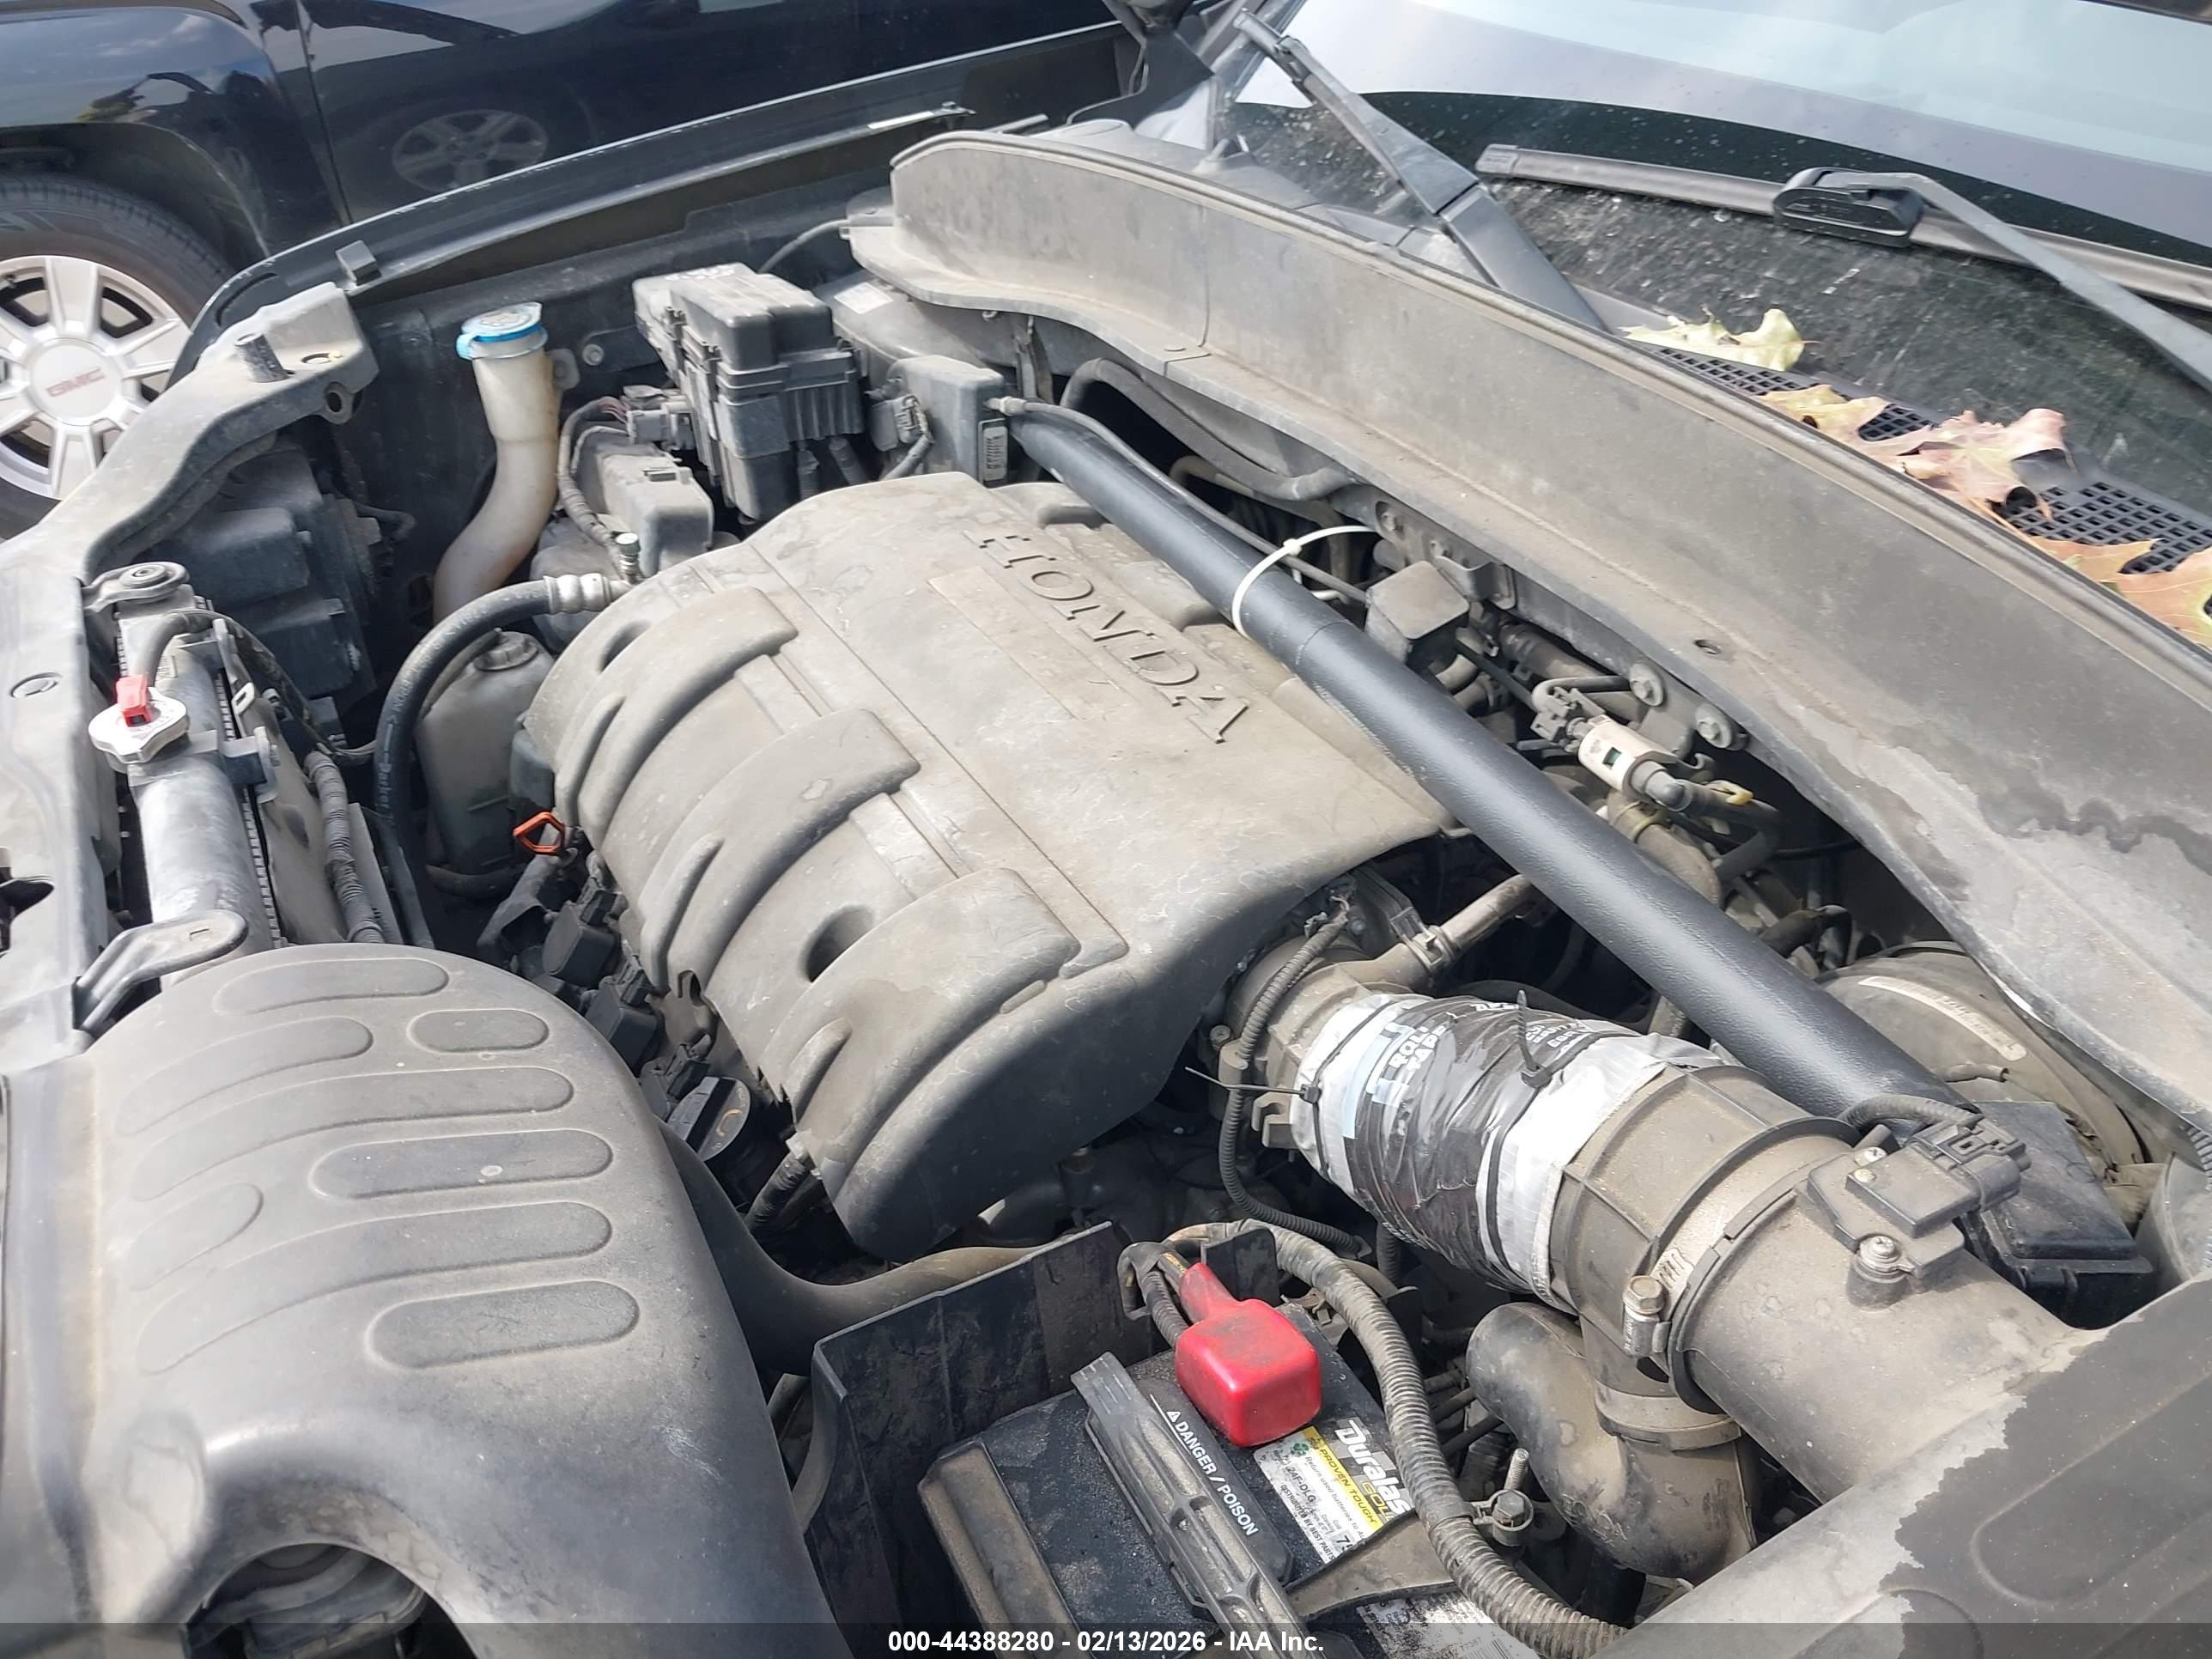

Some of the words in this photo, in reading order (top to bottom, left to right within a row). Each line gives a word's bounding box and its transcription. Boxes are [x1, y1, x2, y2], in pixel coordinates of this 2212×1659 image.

[46, 367, 106, 398] GMC
[963, 531, 1250, 745] HONDA
[1175, 1421, 1217, 1475] DANGER
[1217, 1484, 1259, 1535] POISON
[1287, 1467, 1316, 1503] 24F-DLG
[1305, 1456, 1323, 1480] Return
[1321, 1479, 1334, 1493] used
[1331, 1492, 1352, 1522] batteries
[1320, 1449, 1352, 1487] PROVEN
[1349, 1487, 1377, 1524] TOUGH
[1303, 1516, 1314, 1528] BY
[1310, 1527, 1323, 1542] BEST
